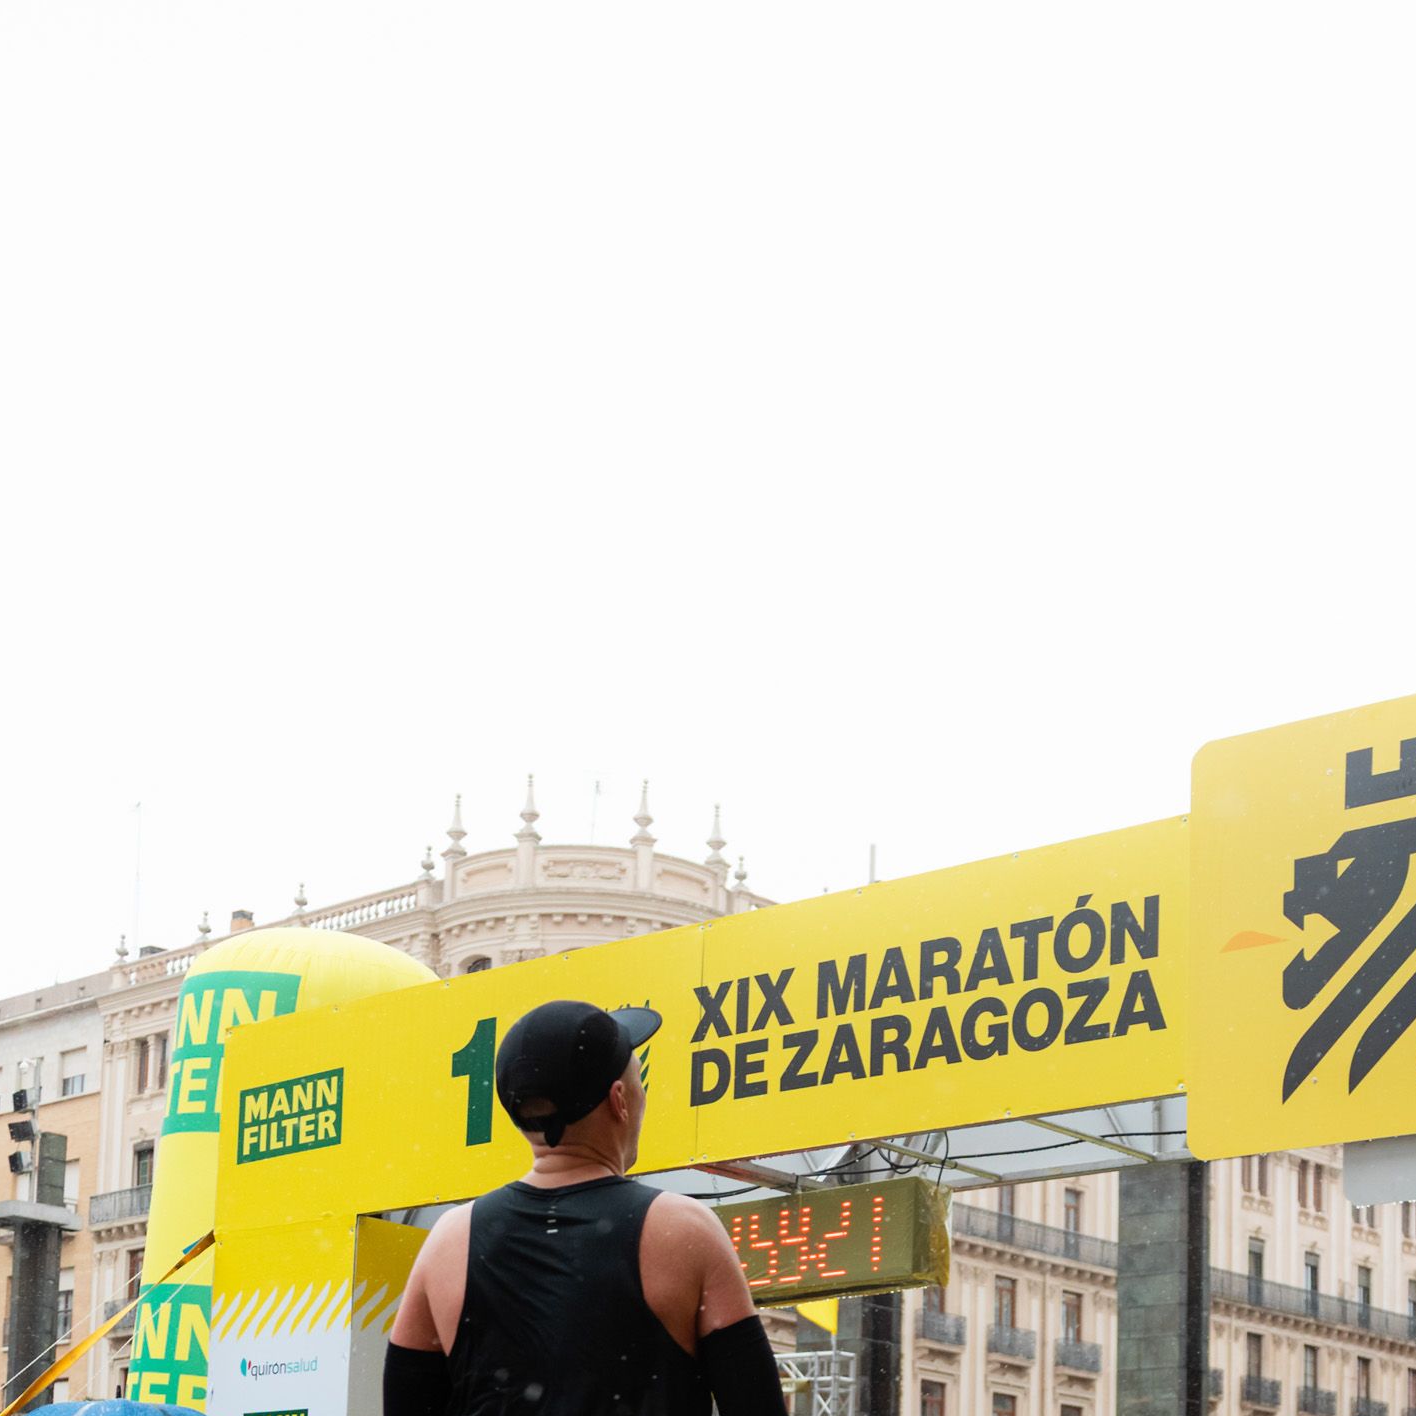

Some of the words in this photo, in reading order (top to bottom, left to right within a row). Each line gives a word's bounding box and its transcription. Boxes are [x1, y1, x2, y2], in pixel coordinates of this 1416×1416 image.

[690, 967, 795, 1043] XIX
[816, 893, 1160, 1019] MARATÓN
[689, 1038, 770, 1107] DE
[779, 970, 1167, 1092] ZARAGOZA
[242, 1109, 338, 1161] FILTER
[243, 1076, 339, 1123] MANN
